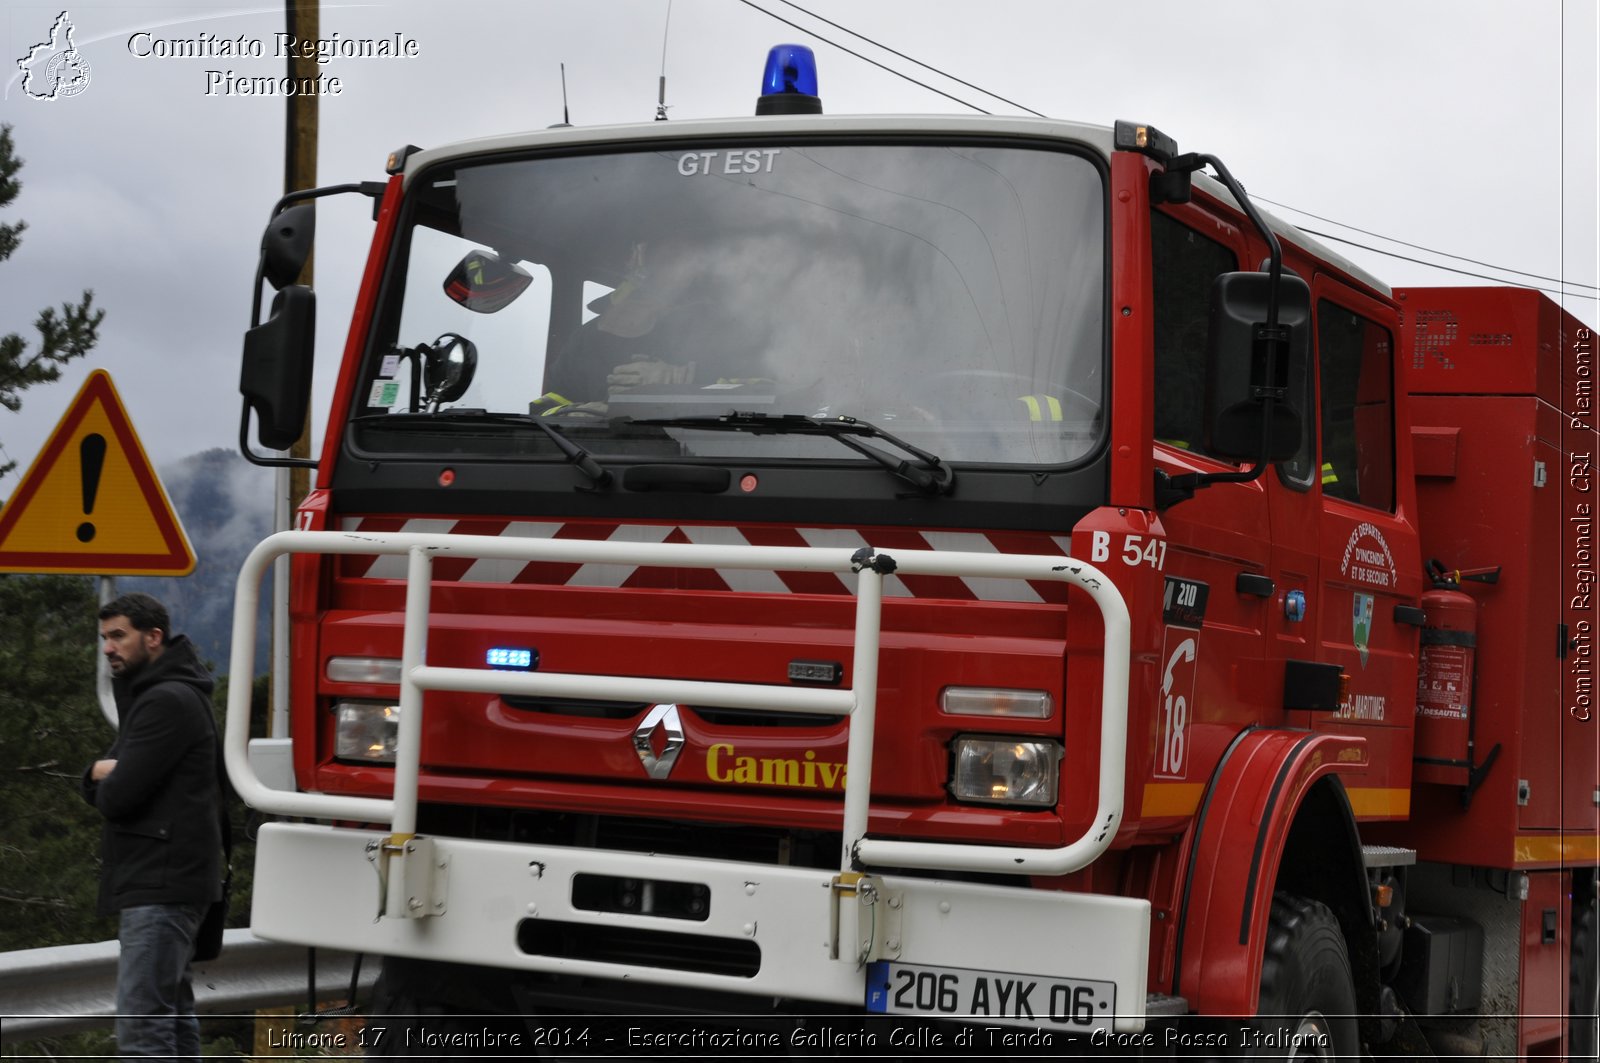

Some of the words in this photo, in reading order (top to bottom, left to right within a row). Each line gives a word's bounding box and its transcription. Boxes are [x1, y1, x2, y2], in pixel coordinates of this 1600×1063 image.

[678, 152, 718, 176] GT
[724, 149, 780, 174] EST
[1091, 530, 1111, 562] B
[1341, 528, 1359, 576] SERVICE
[1355, 547, 1385, 567] D'INCENDIE
[1351, 565, 1358, 580] ET
[1358, 567, 1366, 582] DE
[1366, 569, 1389, 586] SECOURS
[1177, 582, 1198, 607] 210
[1355, 694, 1386, 721] MARITIMES
[1423, 707, 1460, 718] DESAUTEL
[1162, 694, 1187, 774] 18
[706, 743, 848, 789] Camiv
[872, 992, 881, 1004] F
[894, 970, 959, 1013] 206
[971, 977, 1037, 1021] AYK
[1050, 984, 1095, 1026] 06
